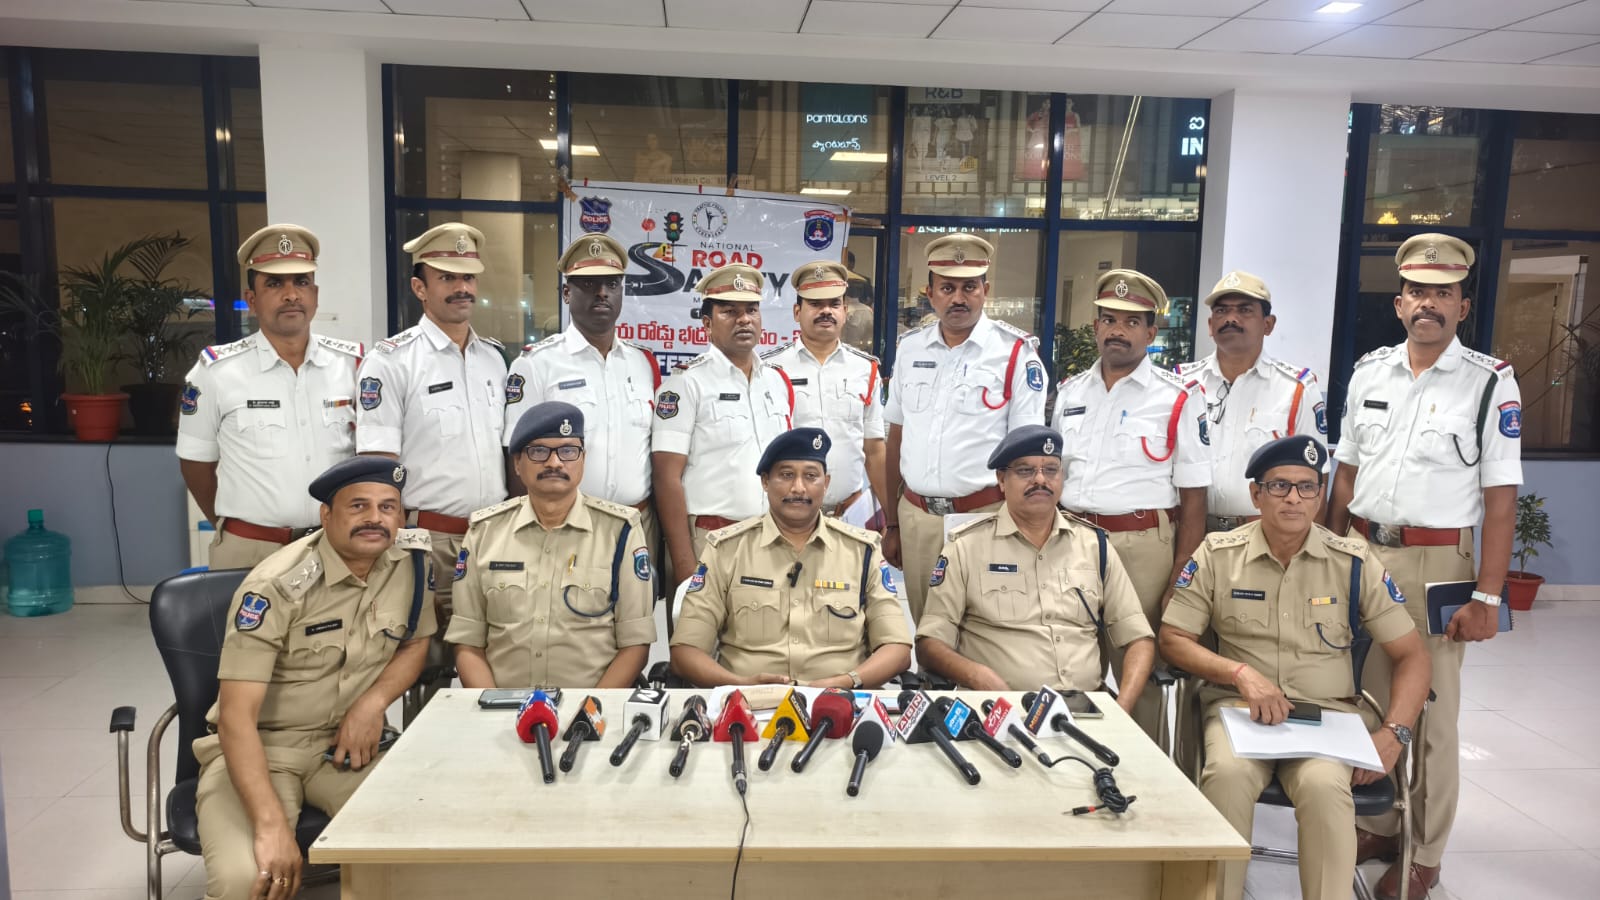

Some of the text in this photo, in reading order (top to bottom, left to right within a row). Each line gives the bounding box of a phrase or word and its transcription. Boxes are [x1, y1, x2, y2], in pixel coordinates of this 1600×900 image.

[700, 241, 755, 251] NATIONAL
[692, 250, 763, 270] ROAD
[637, 321, 675, 349] రోడ్డు
